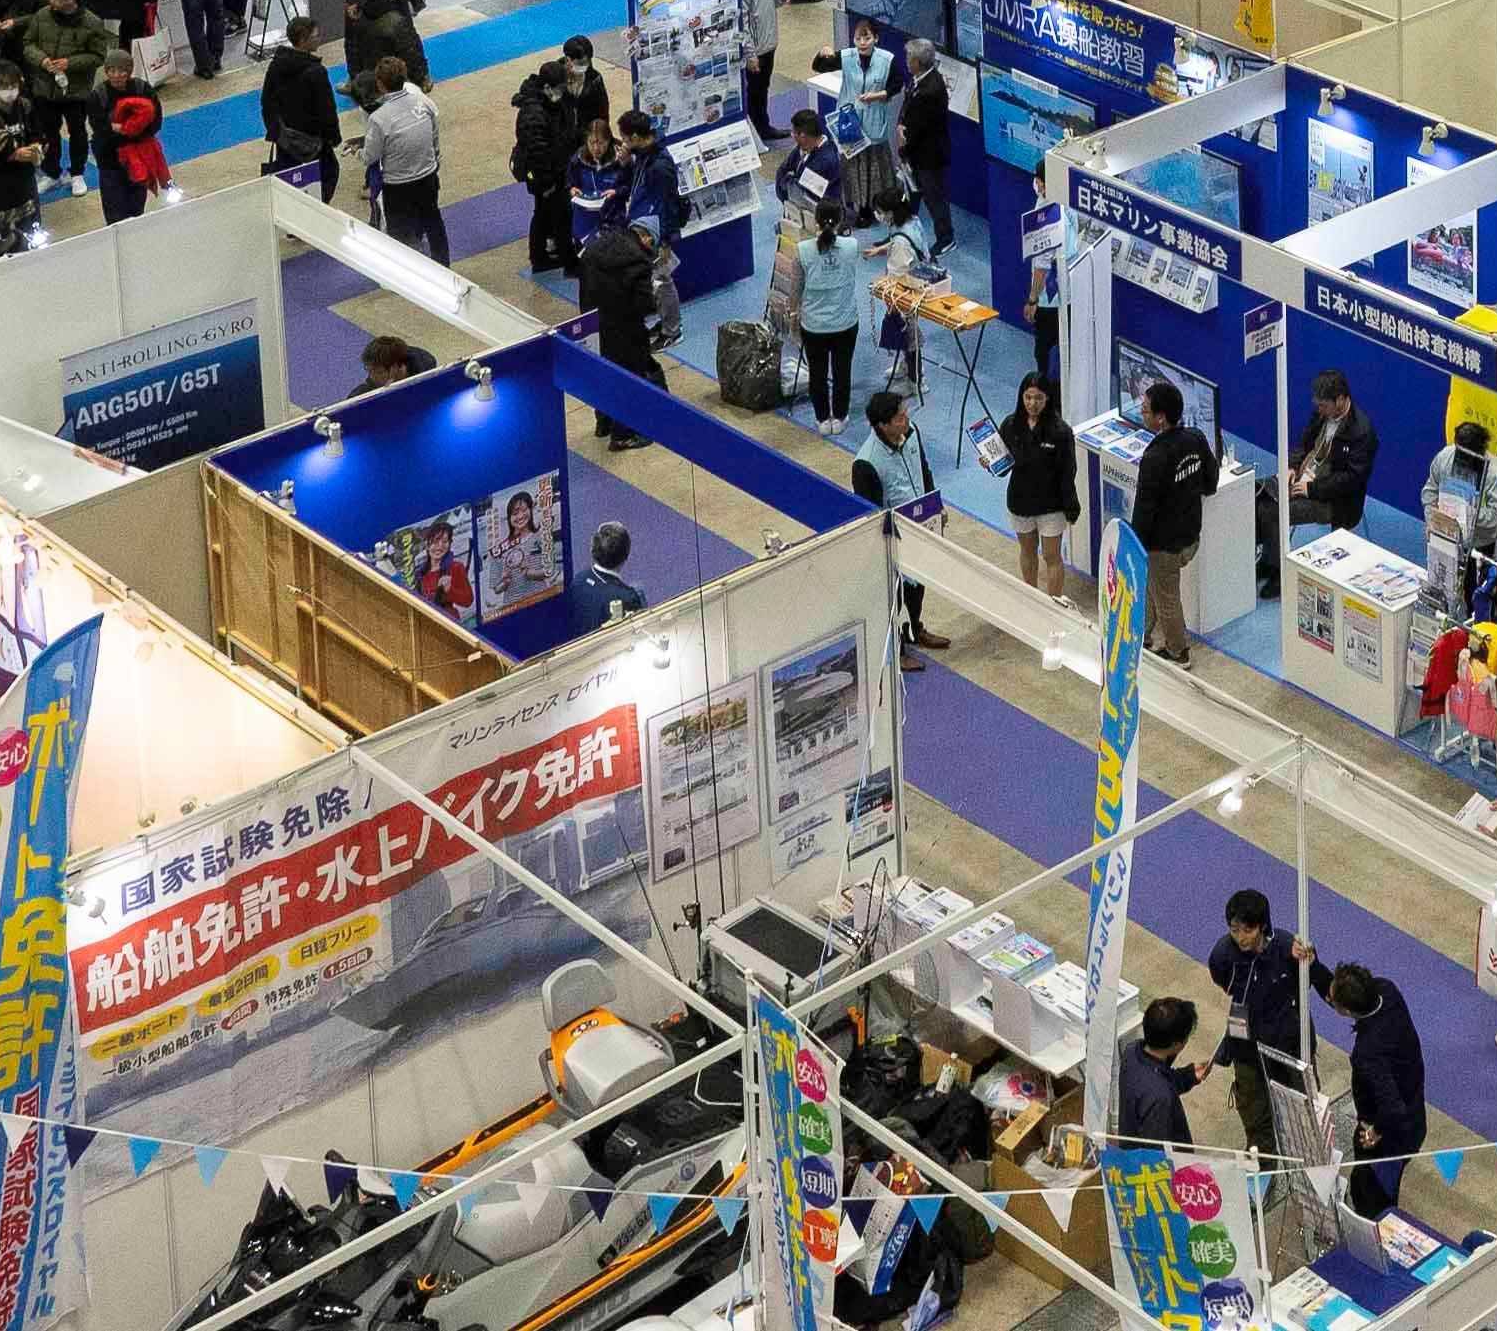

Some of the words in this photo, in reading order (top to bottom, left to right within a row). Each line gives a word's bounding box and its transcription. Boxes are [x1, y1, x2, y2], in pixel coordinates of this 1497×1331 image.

[1078, 186, 1230, 271] 日本マリン事業協会
[1317, 286, 1483, 375] 日本小型船舶検査機構
[75, 363, 222, 433] ARG50T/65T
[449, 694, 560, 749] マリンライセンス
[86, 723, 623, 1013] 船舶免許・水上バイク免許
[120, 788, 351, 916] 国家試験免除
[1175, 1176, 1220, 1209] 安心
[1191, 1235, 1235, 1266] 確実
